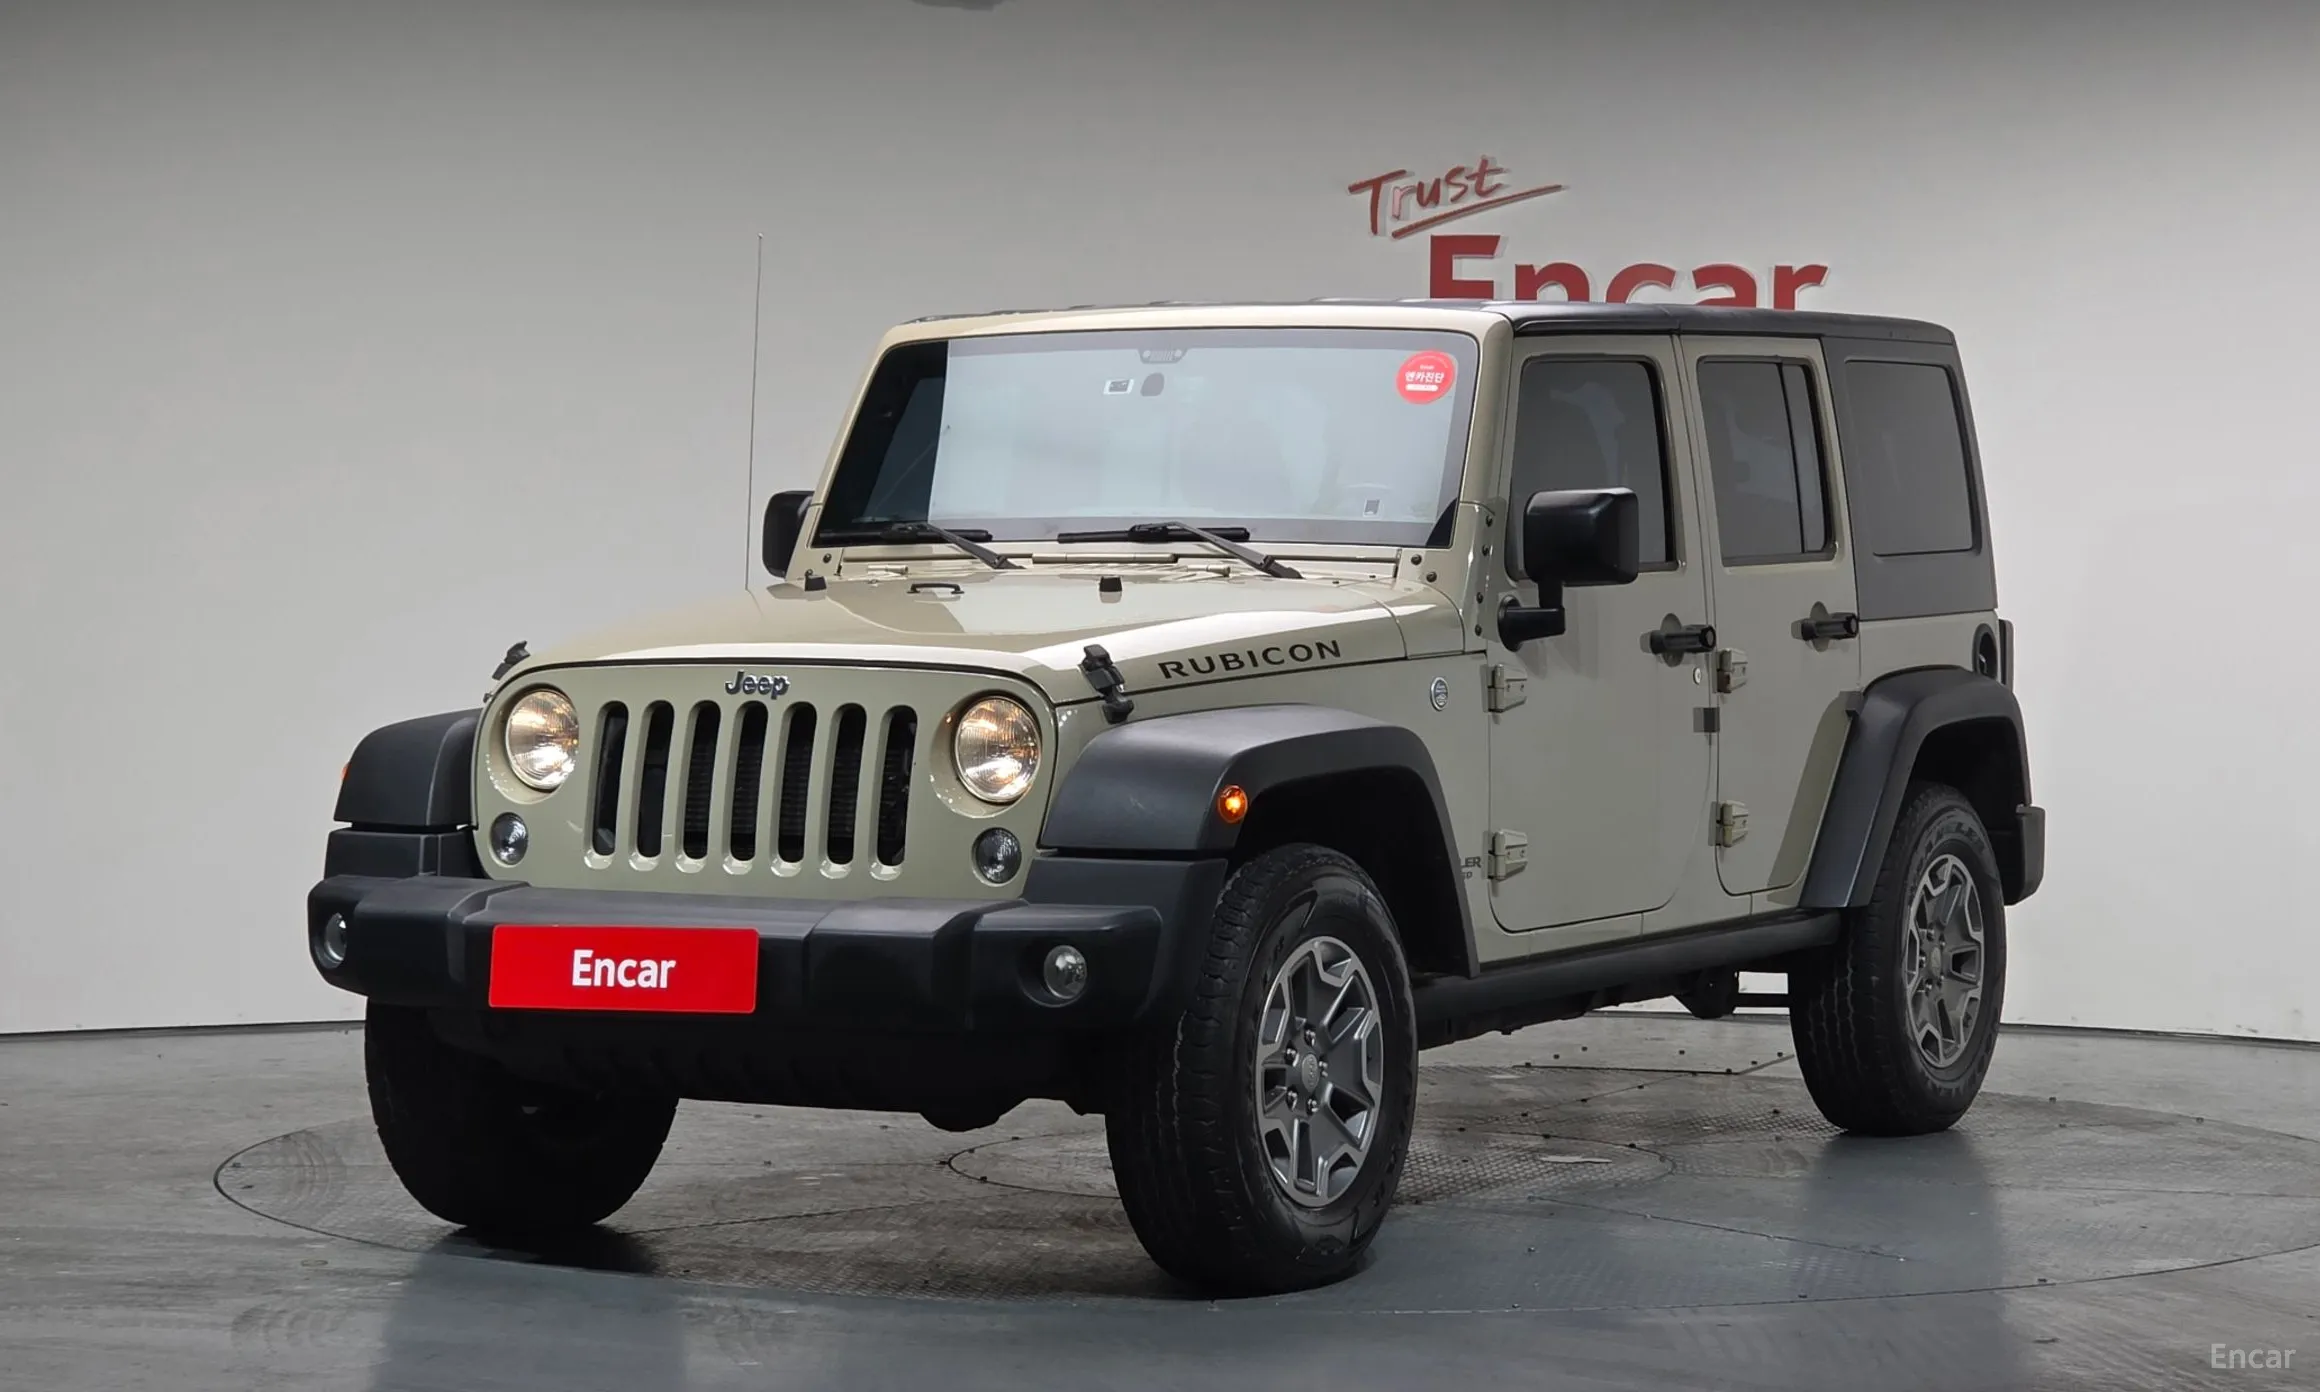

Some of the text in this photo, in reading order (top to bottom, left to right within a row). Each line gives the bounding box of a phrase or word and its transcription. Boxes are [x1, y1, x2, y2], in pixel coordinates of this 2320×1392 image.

[1348, 156, 1502, 235] Trust
[1158, 640, 1341, 679] RUBICON
[724, 669, 790, 701] Jeep
[571, 948, 677, 989] Encar
